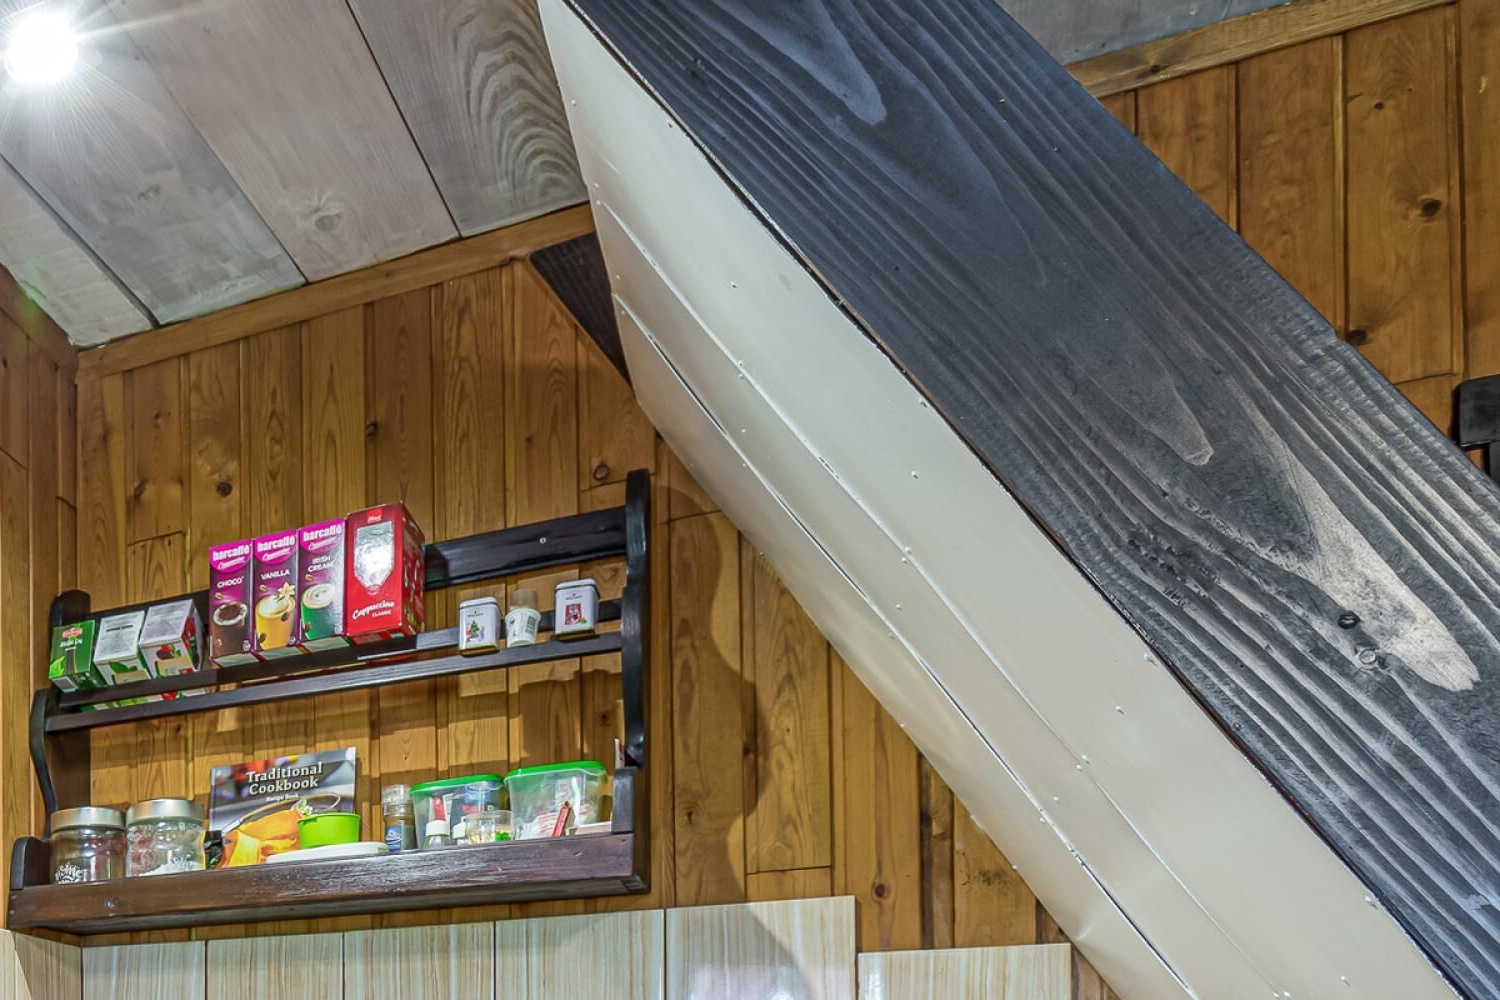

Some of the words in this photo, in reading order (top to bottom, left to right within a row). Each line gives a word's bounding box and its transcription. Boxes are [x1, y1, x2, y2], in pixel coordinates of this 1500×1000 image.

[261, 569, 290, 580] VANILLA
[245, 761, 322, 783] Traditional
[249, 776, 318, 795] Cookbook
